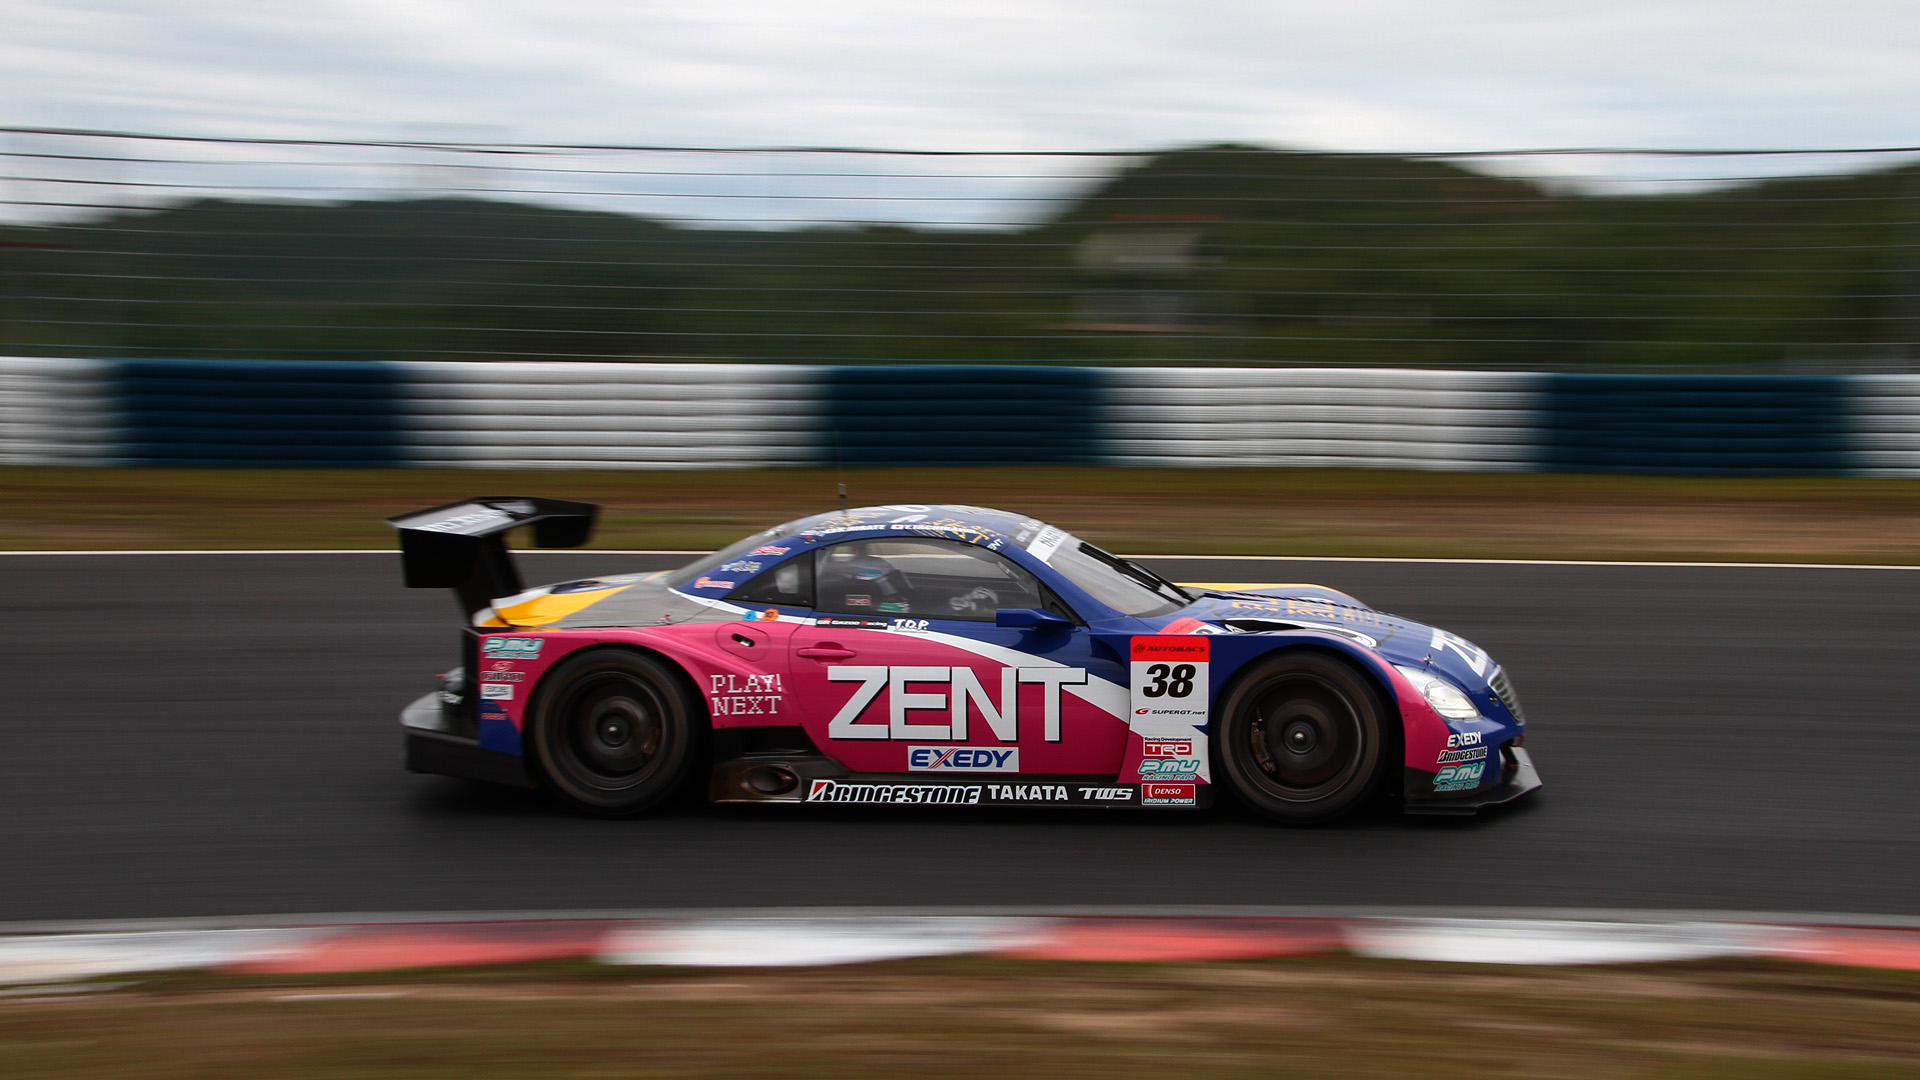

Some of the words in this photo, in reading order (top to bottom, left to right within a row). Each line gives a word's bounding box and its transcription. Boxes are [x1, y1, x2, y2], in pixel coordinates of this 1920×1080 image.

[710, 674, 782, 694] PLAY!
[1143, 664, 1196, 698] 38
[711, 696, 782, 716] NEXT
[827, 665, 1088, 743] ZENT
[1146, 744, 1190, 755] TRD
[1447, 731, 1482, 748] EXEDY
[910, 748, 1014, 769] EXEDY
[1437, 746, 1488, 763] BRIDGESTONE
[806, 780, 982, 804] BRIDGESTONE
[987, 785, 1069, 800] TAKATA
[1078, 787, 1133, 800] TWS
